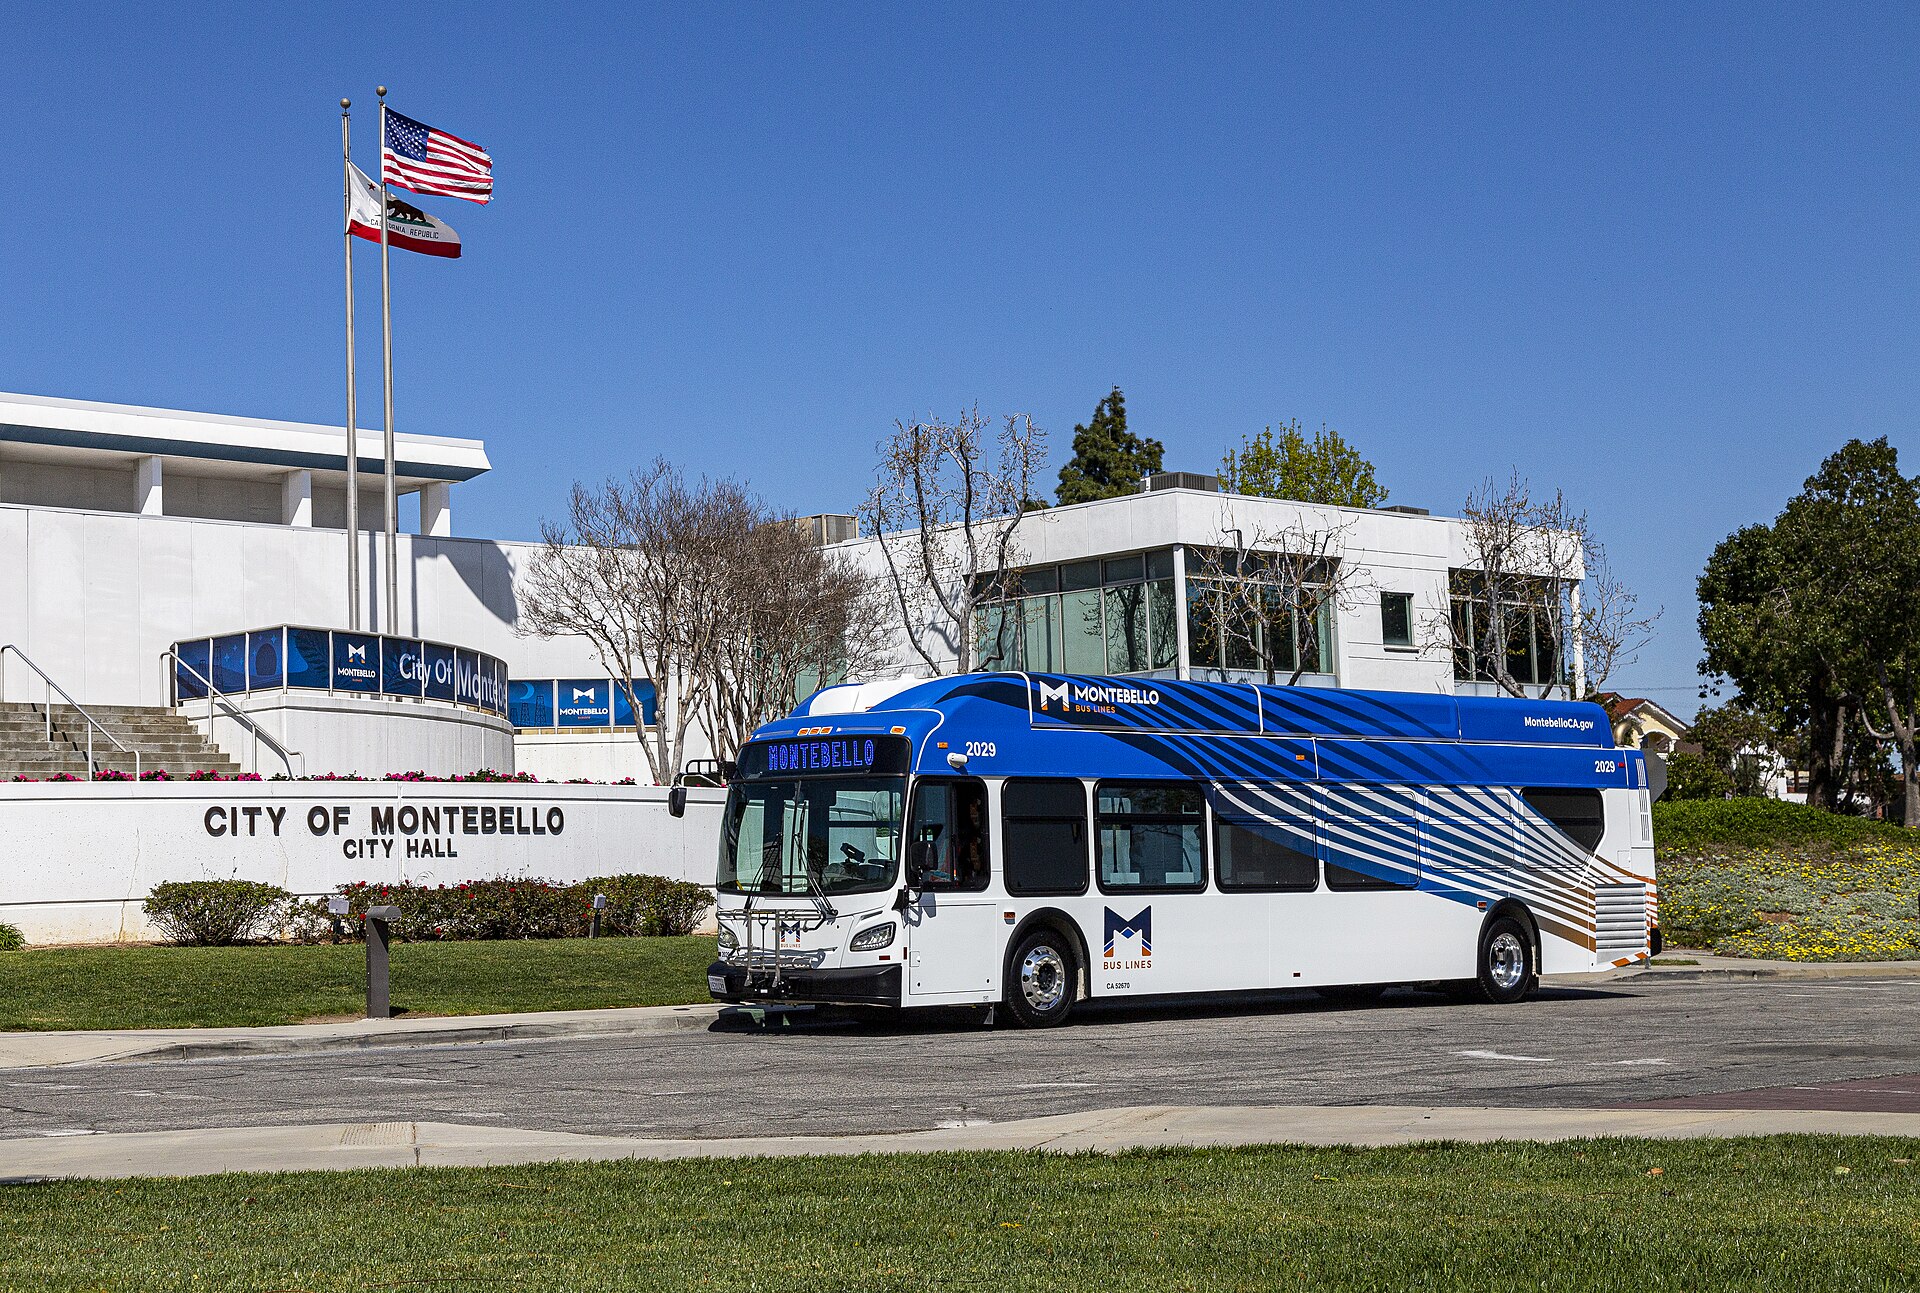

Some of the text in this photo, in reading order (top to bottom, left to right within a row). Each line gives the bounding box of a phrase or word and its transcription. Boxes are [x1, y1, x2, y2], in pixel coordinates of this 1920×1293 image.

[409, 228, 439, 239] REPUBLIC
[337, 667, 376, 678] MONTEBELLO
[399, 653, 431, 688] City
[435, 658, 453, 684] Of
[1074, 685, 1160, 705] MONTEBELLO
[559, 708, 609, 716] MONTEBELLO
[1075, 704, 1116, 714] BUS LINES
[1524, 716, 1594, 731] MontebelloCA.gov
[768, 740, 874, 770] MONTEBELLO
[965, 741, 996, 757] 2029
[1594, 760, 1616, 773] 2029
[204, 805, 564, 837] CITY OF MONTEBELLO
[343, 838, 458, 859] CITY HALL
[1103, 960, 1152, 970] BUS LINES
[1115, 982, 1130, 990] 52670
